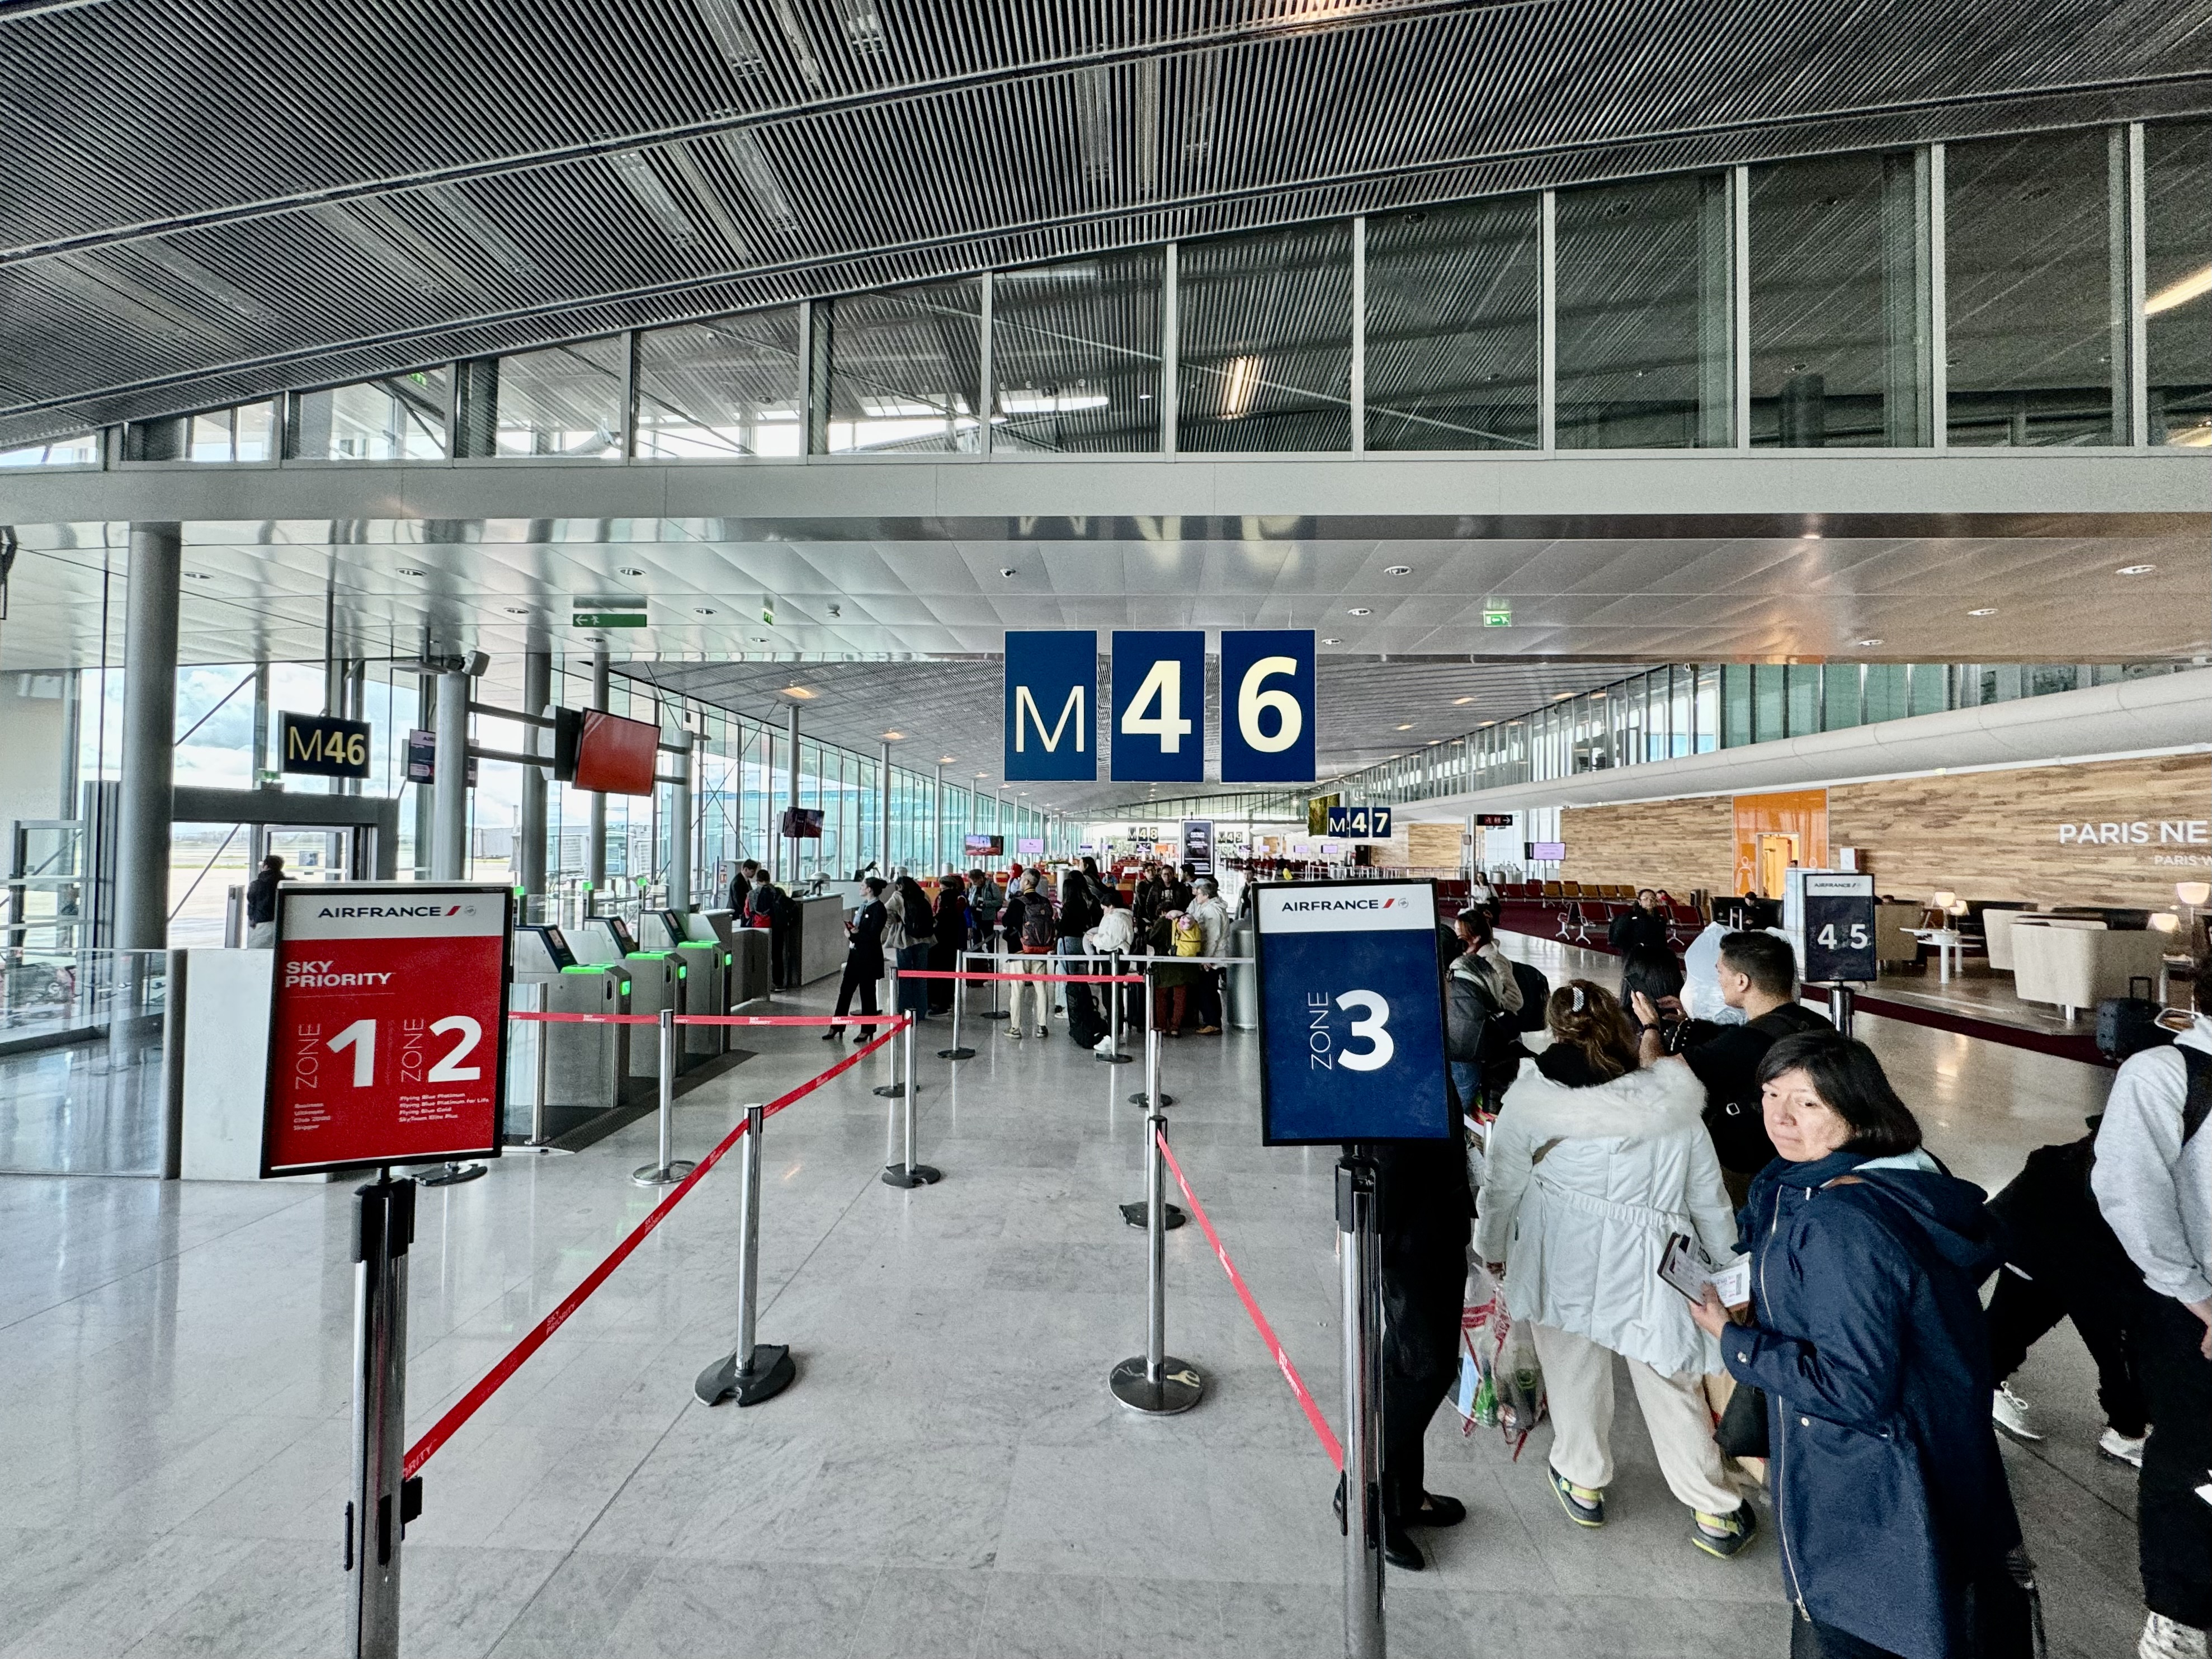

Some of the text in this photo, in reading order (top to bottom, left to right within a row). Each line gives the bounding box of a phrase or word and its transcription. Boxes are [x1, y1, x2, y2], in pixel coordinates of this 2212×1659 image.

[289, 726, 365, 766] M46
[1329, 812, 1388, 833] M47
[2059, 820, 2209, 843] PARIS NE
[2154, 855, 2197, 866] PARIS
[318, 906, 441, 918] AIRFRANCE
[1281, 899, 1379, 912] AIRFRANCE
[1818, 923, 1837, 950] 4
[1850, 924, 1868, 949] 5
[286, 960, 334, 974] SKY
[285, 972, 393, 988] PRIORITY
[1307, 989, 1394, 1071] ZONE 3
[295, 1019, 376, 1090] ZONE 1
[400, 1015, 482, 1083] ZONE 2
[546, 1301, 576, 1336] PRIORITY
